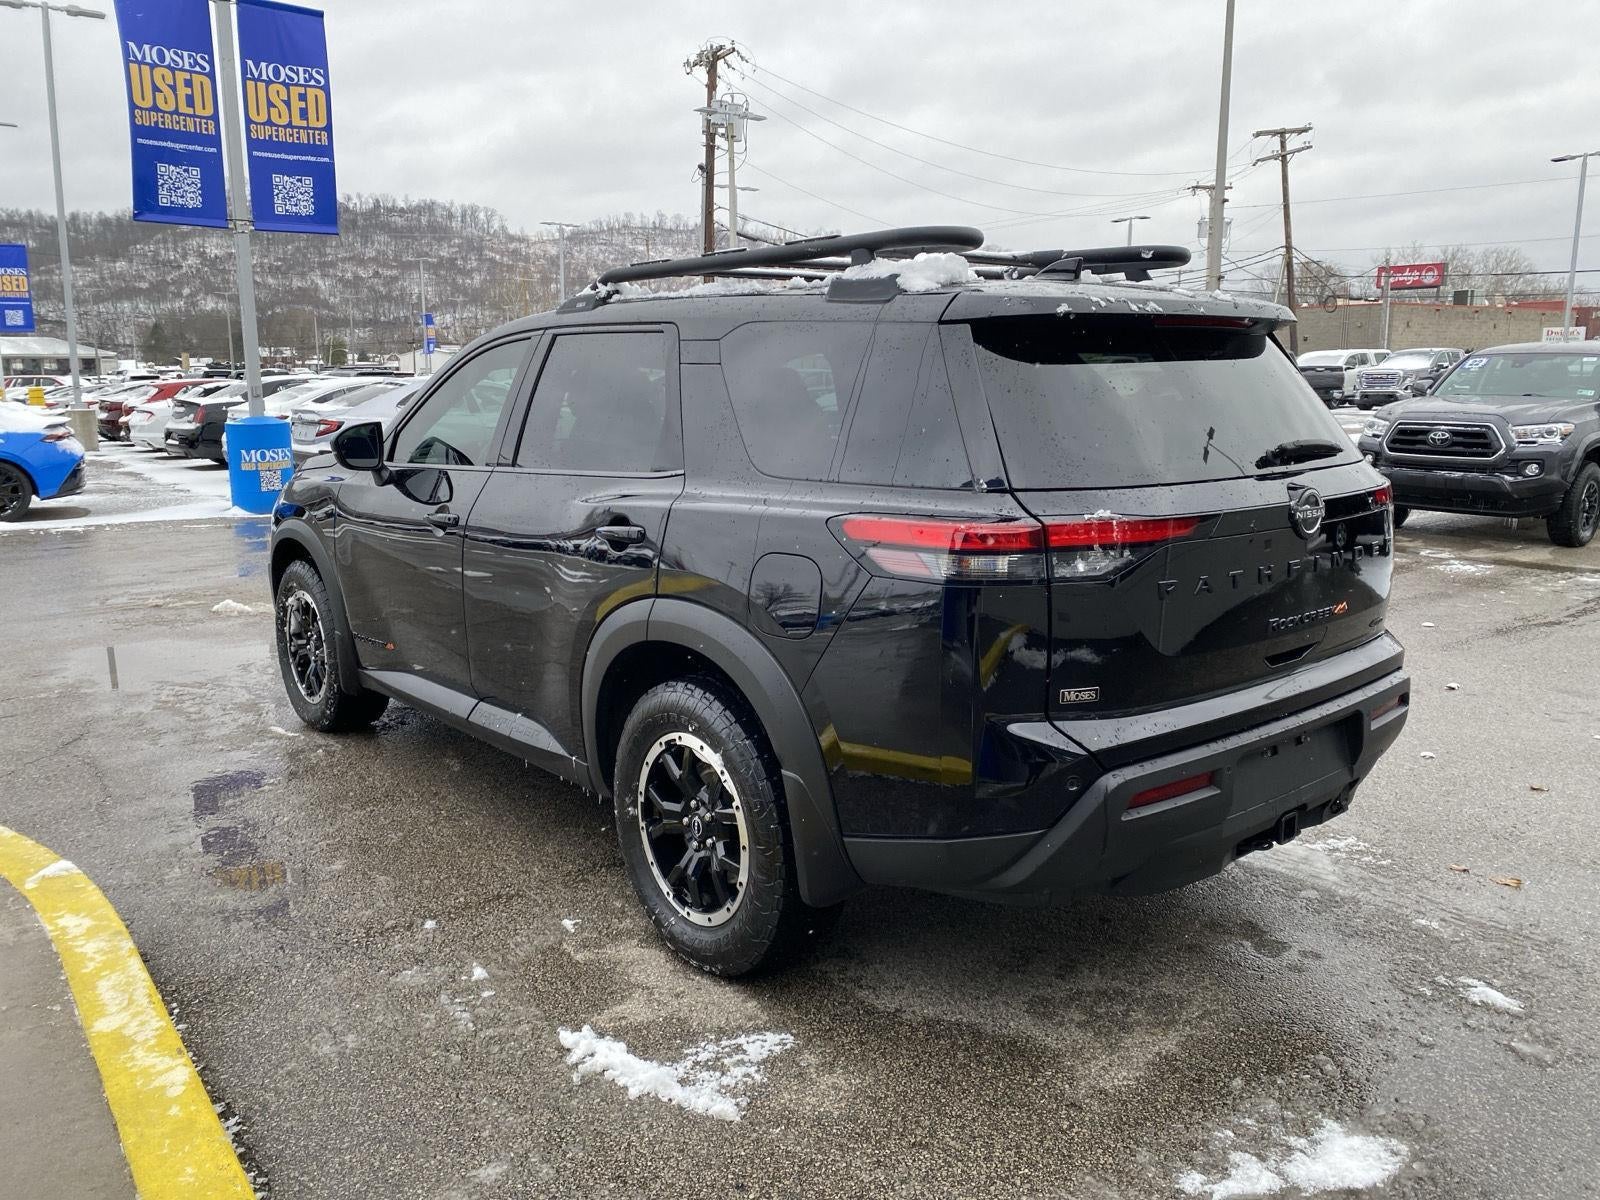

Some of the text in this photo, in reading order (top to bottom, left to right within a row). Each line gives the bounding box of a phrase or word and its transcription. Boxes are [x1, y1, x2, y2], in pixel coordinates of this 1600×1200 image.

[126, 41, 210, 73] MOSES
[245, 59, 325, 86] MOSES
[129, 63, 214, 117] USED
[246, 80, 327, 128] USED
[134, 109, 216, 135] SUPERCENTER
[136, 138, 217, 153] mosesusedsupercenter.com
[250, 124, 328, 146] SUPERCENTER
[252, 151, 330, 162] mosesusedsupercenter.com
[0, 275, 29, 291] SED
[240, 448, 291, 463] MOSES
[1063, 690, 1096, 702] MOSES
